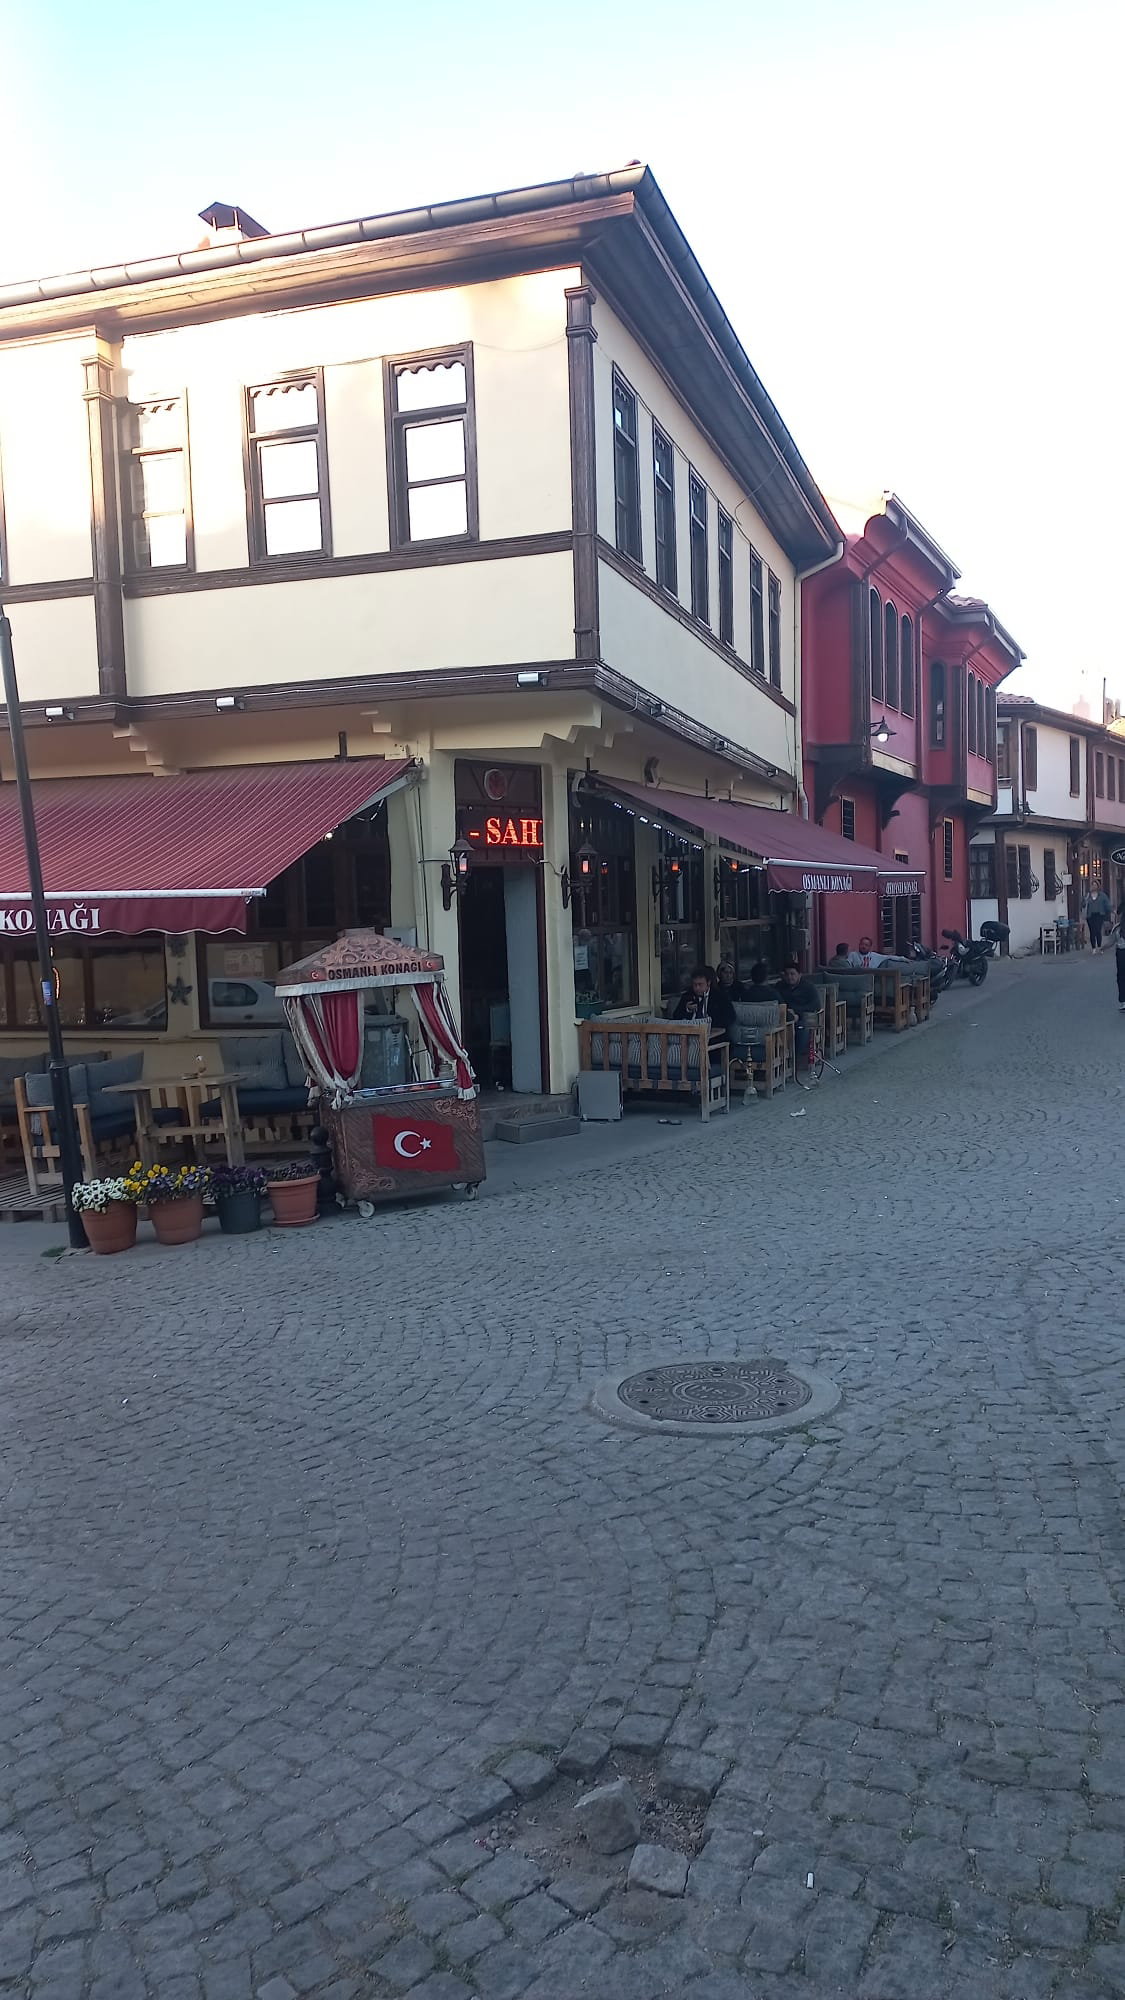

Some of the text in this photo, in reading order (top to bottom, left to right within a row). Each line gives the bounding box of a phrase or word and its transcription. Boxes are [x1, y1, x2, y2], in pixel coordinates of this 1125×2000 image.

[802, 874, 830, 890] OSMANLI
[328, 959, 422, 980] OSMANLI KONAĞI
